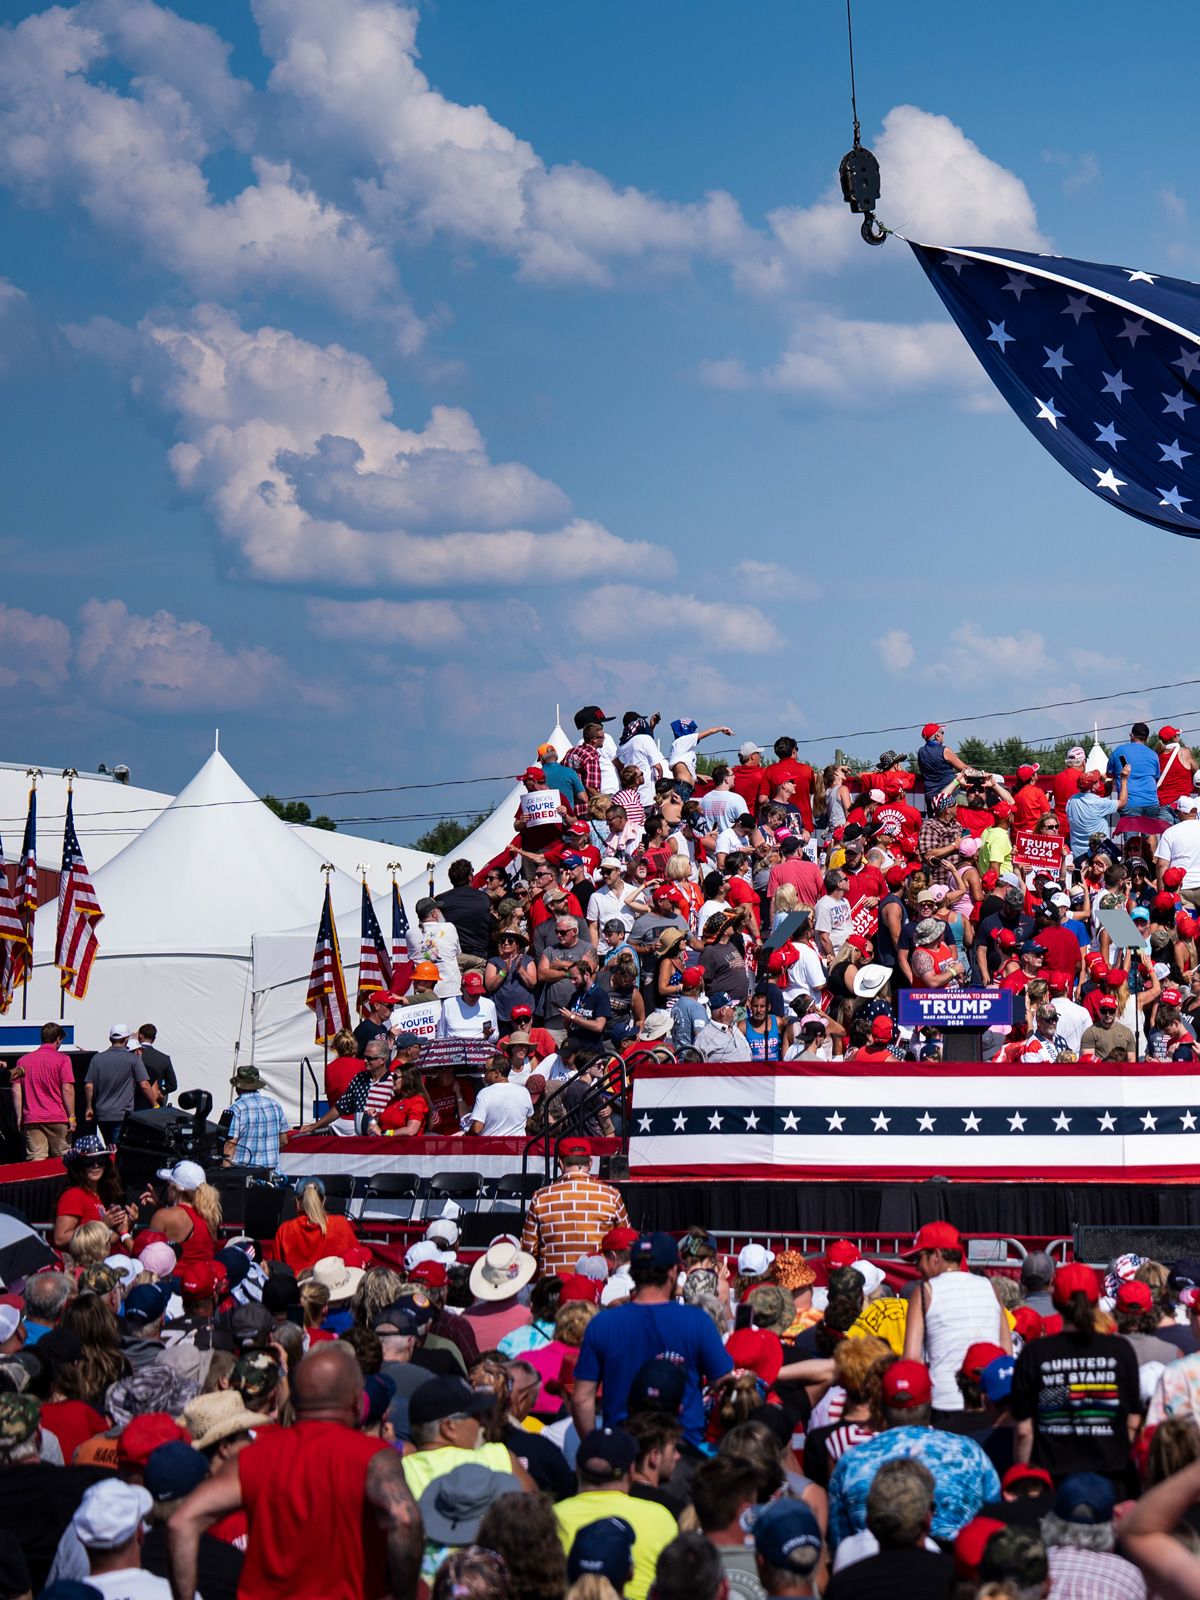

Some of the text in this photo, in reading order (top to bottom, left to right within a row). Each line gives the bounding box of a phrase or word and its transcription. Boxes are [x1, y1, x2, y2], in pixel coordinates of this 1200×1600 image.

[526, 802, 555, 812] YOU'RE
[1020, 838, 1060, 850] TRUMP
[1024, 847, 1053, 858] 2024
[919, 1000, 992, 1014] TRUMP
[412, 1009, 432, 1018] BIDEN
[400, 1016, 435, 1028] YOU'RE
[1051, 1357, 1107, 1370] UNITED
[1042, 1371, 1116, 1385] WE STAND
[1091, 1425, 1114, 1436] FALL
